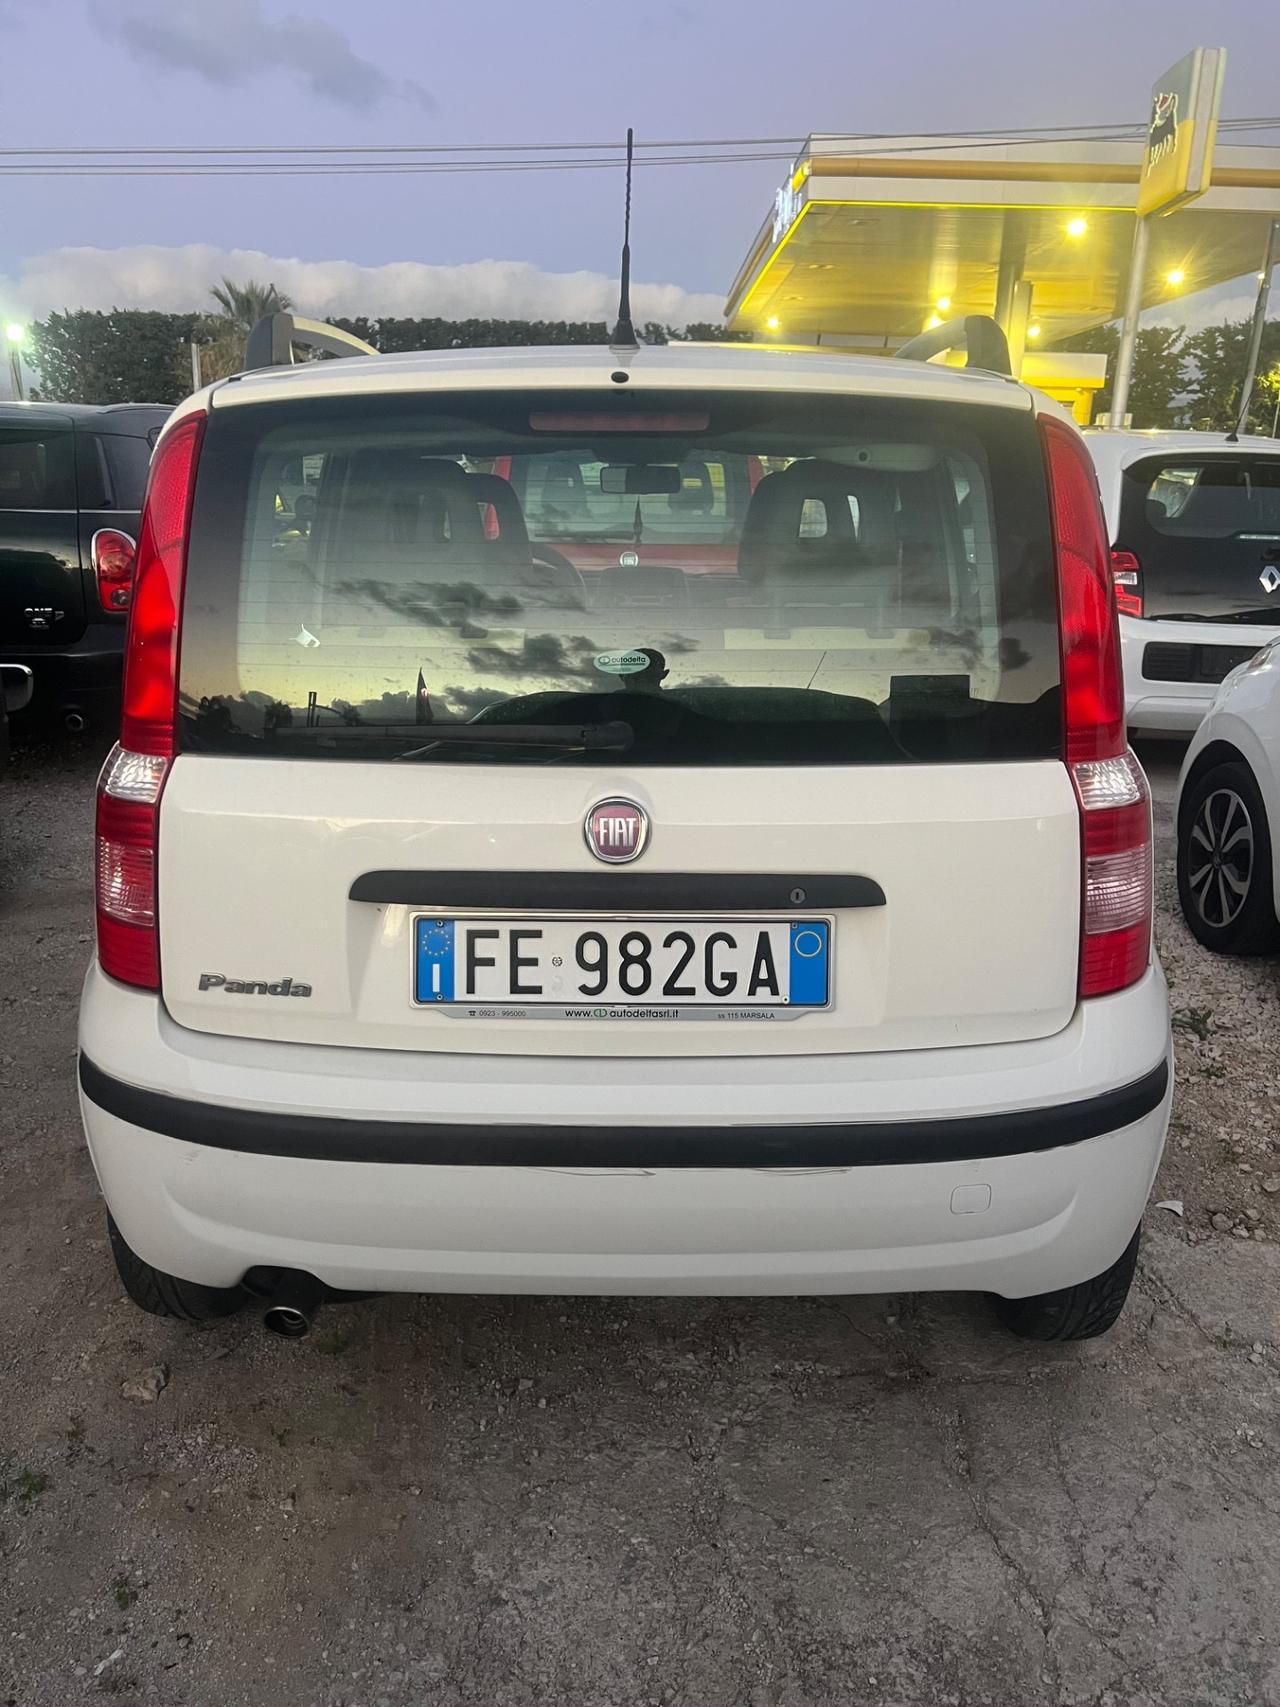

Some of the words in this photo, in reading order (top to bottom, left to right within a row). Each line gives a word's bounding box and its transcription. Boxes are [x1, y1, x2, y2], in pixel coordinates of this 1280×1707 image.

[599, 817, 636, 846] FIAT
[466, 929, 542, 994] FE
[575, 930, 780, 996] 982GA
[198, 972, 312, 997] Panda
[432, 963, 440, 992] I
[478, 1009, 496, 1017] 0923
[740, 1012, 775, 1020] MARSALA
